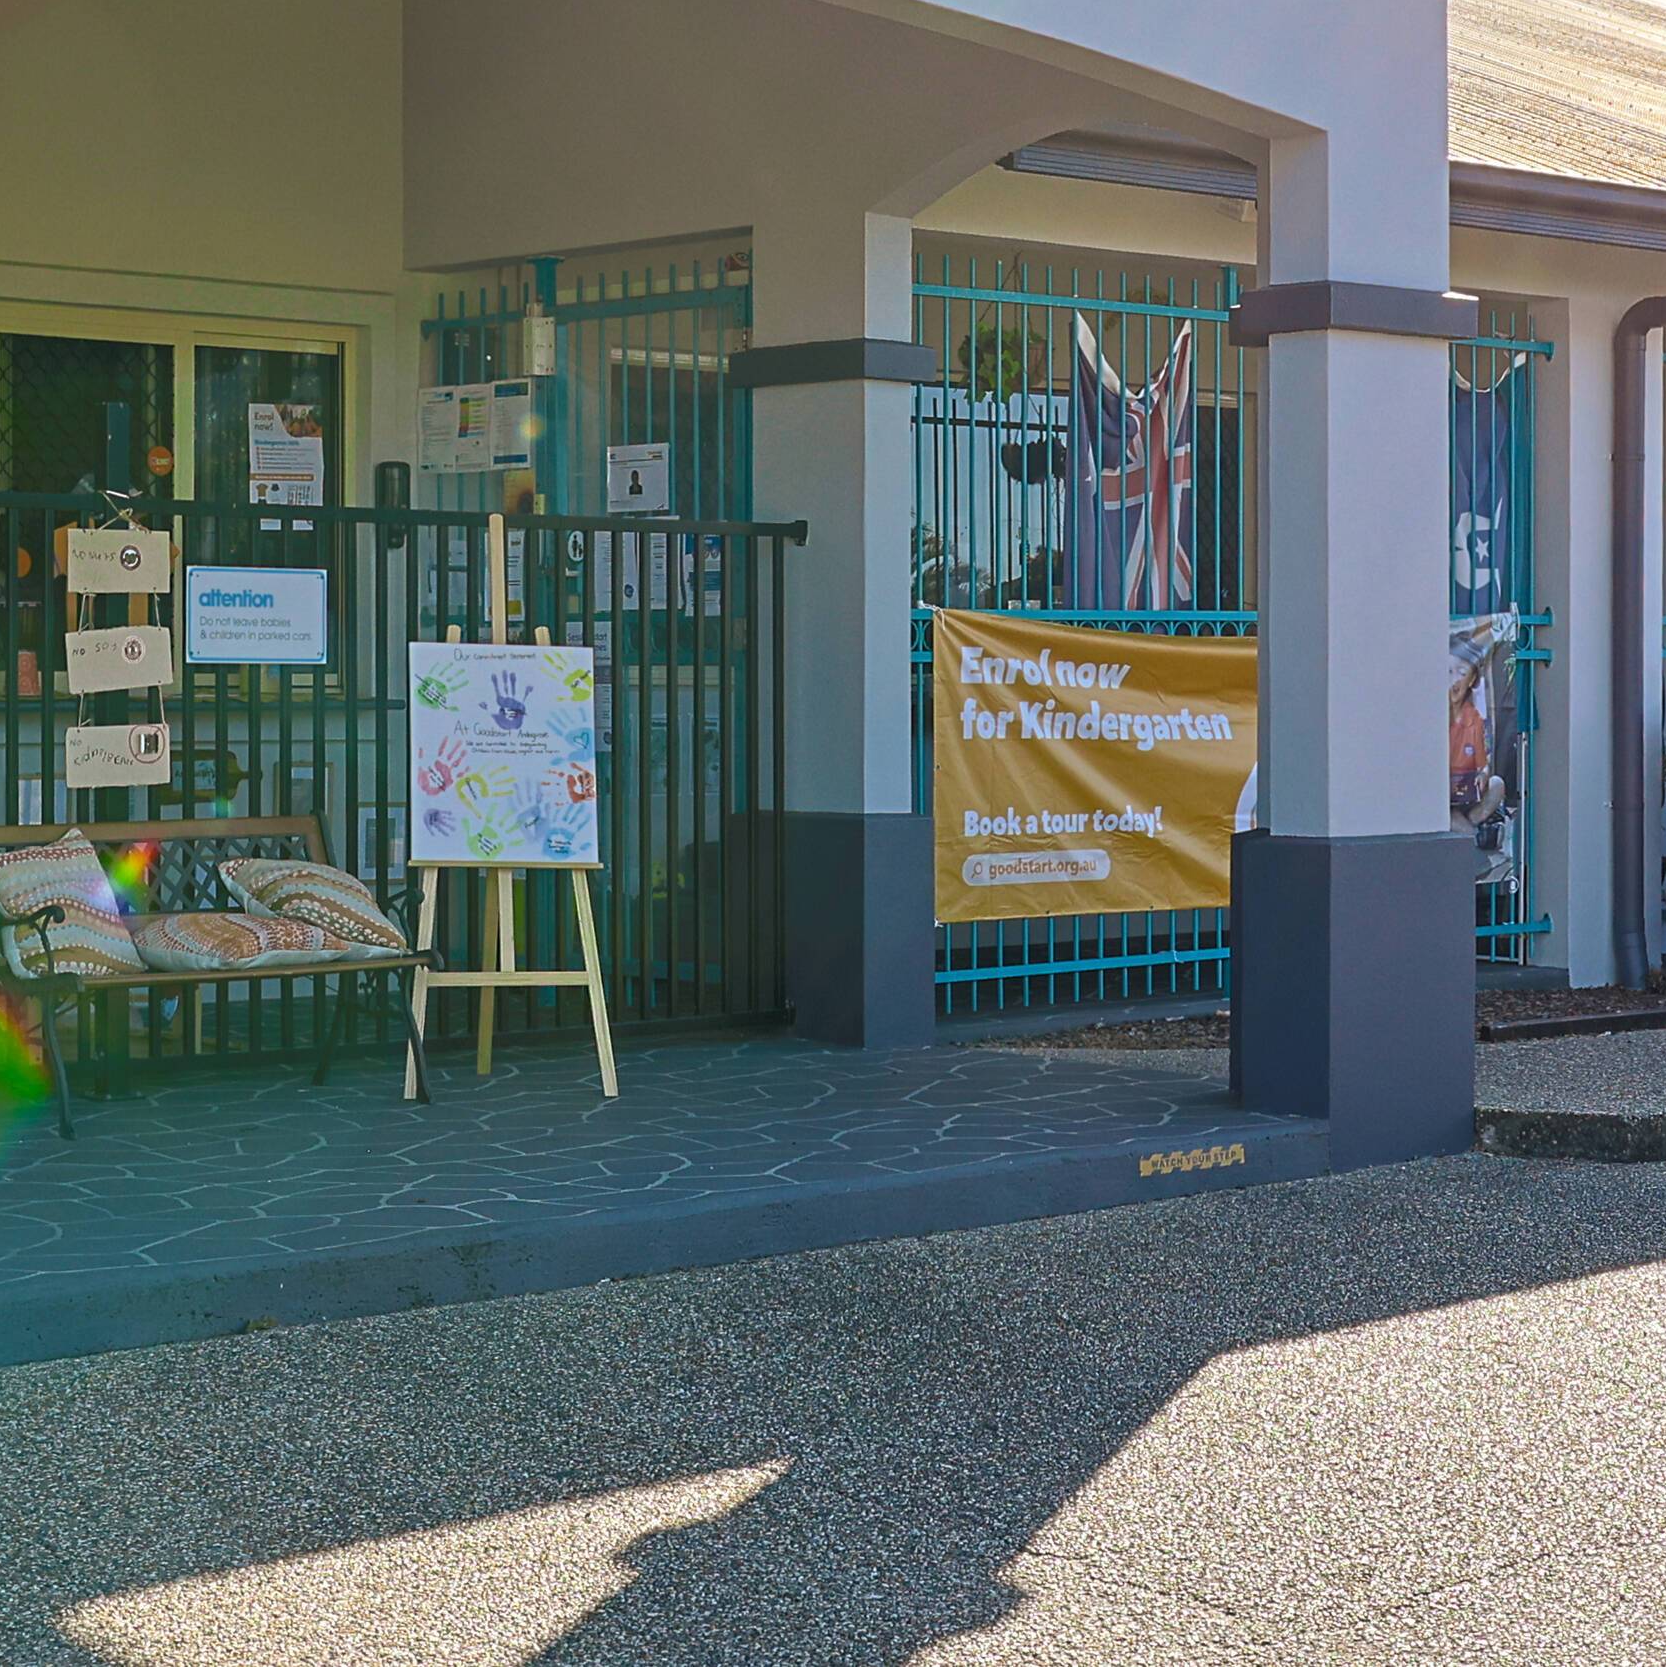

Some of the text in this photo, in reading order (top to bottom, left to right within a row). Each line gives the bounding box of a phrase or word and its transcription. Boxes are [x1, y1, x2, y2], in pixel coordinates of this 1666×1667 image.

[199, 588, 274, 608] attention
[200, 616, 291, 628] Do not leave babies
[200, 629, 207, 640] &
[209, 629, 246, 640] children
[248, 630, 257, 640] in
[258, 631, 290, 642] parked
[72, 647, 86, 656] NO
[454, 647, 471, 662] Our
[960, 645, 1132, 690] Enrol now
[454, 719, 469, 736] At
[960, 697, 1233, 752] for Kindergarten
[964, 804, 1163, 839] Book a tour today!
[989, 857, 1098, 880] goodstart.org.au
